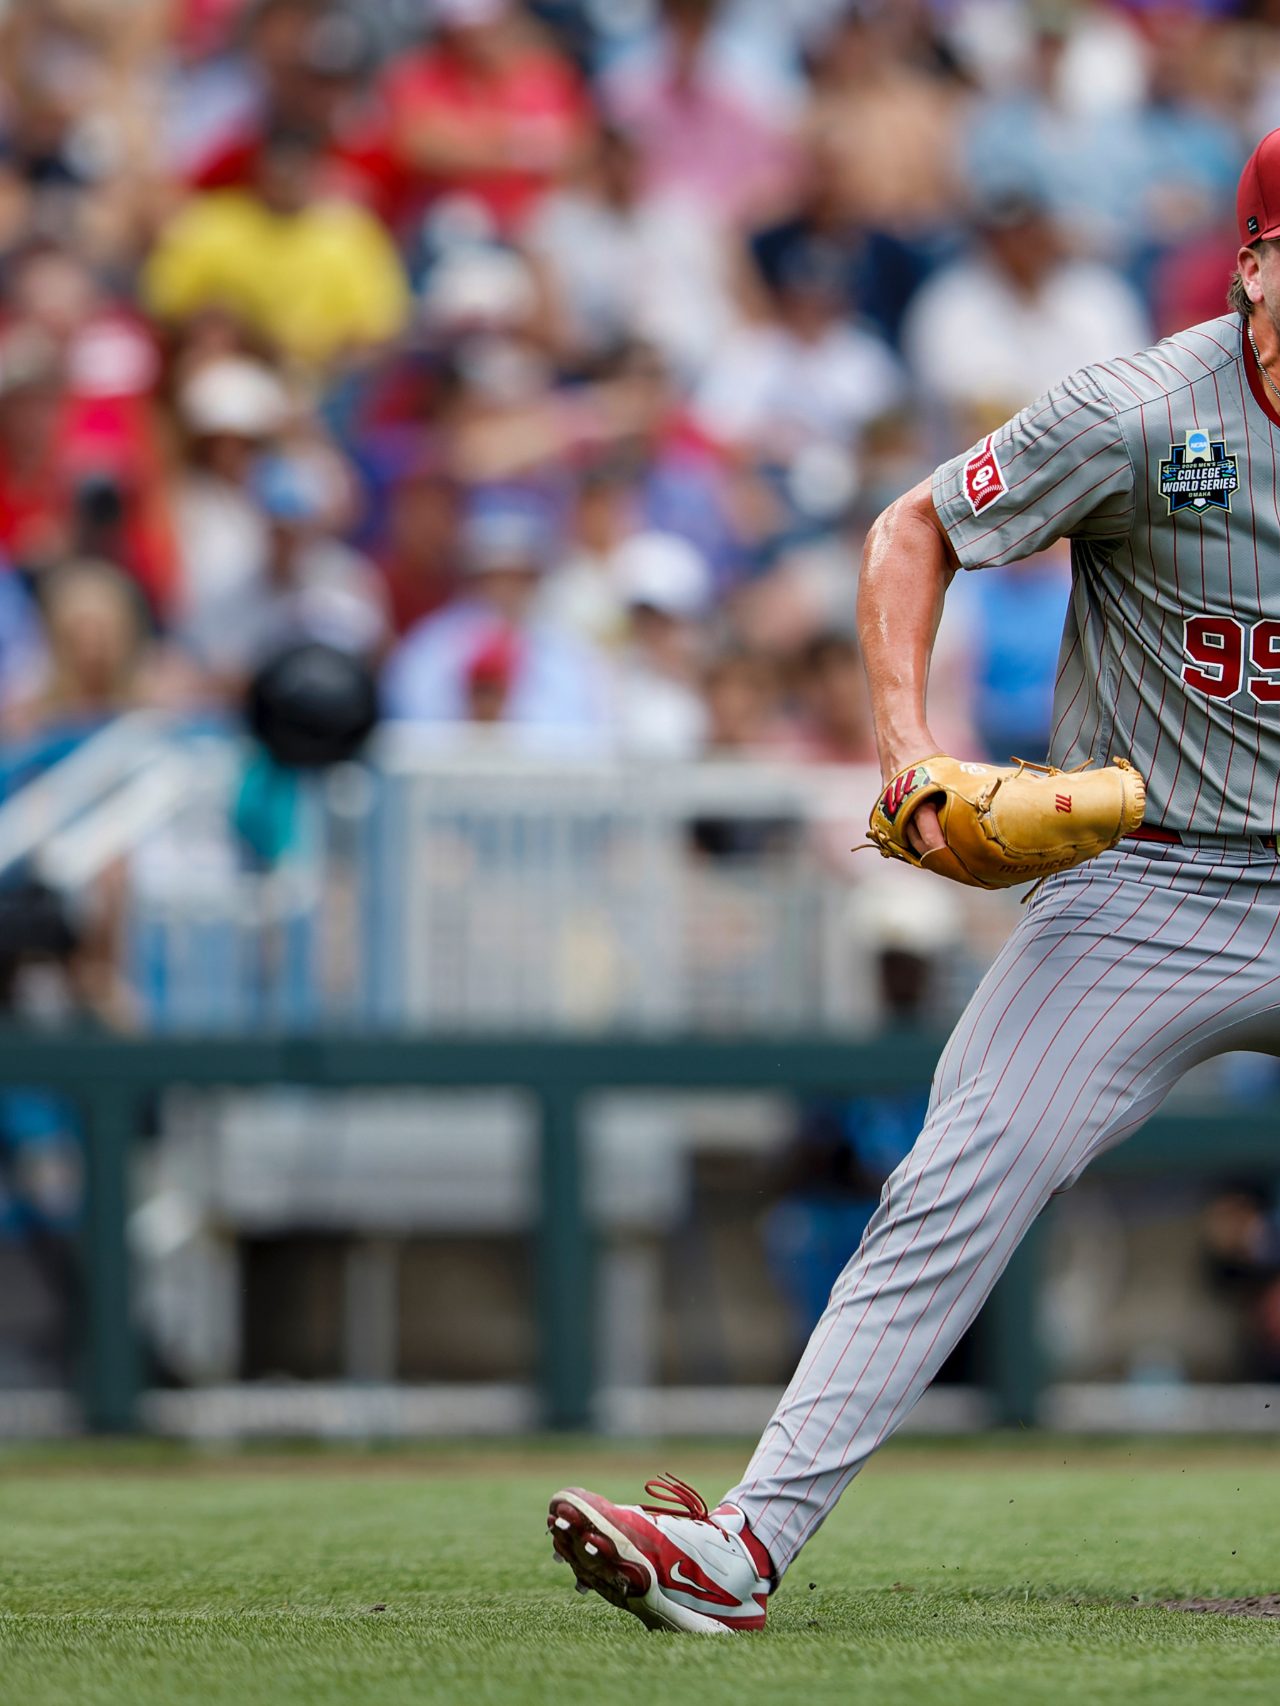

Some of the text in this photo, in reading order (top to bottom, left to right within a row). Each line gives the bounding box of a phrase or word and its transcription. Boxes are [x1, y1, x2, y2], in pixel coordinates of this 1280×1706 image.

[1177, 467, 1221, 480] COLLEGE
[1162, 477, 1236, 493] WORLD SERIES
[998, 855, 1077, 874] marucci
